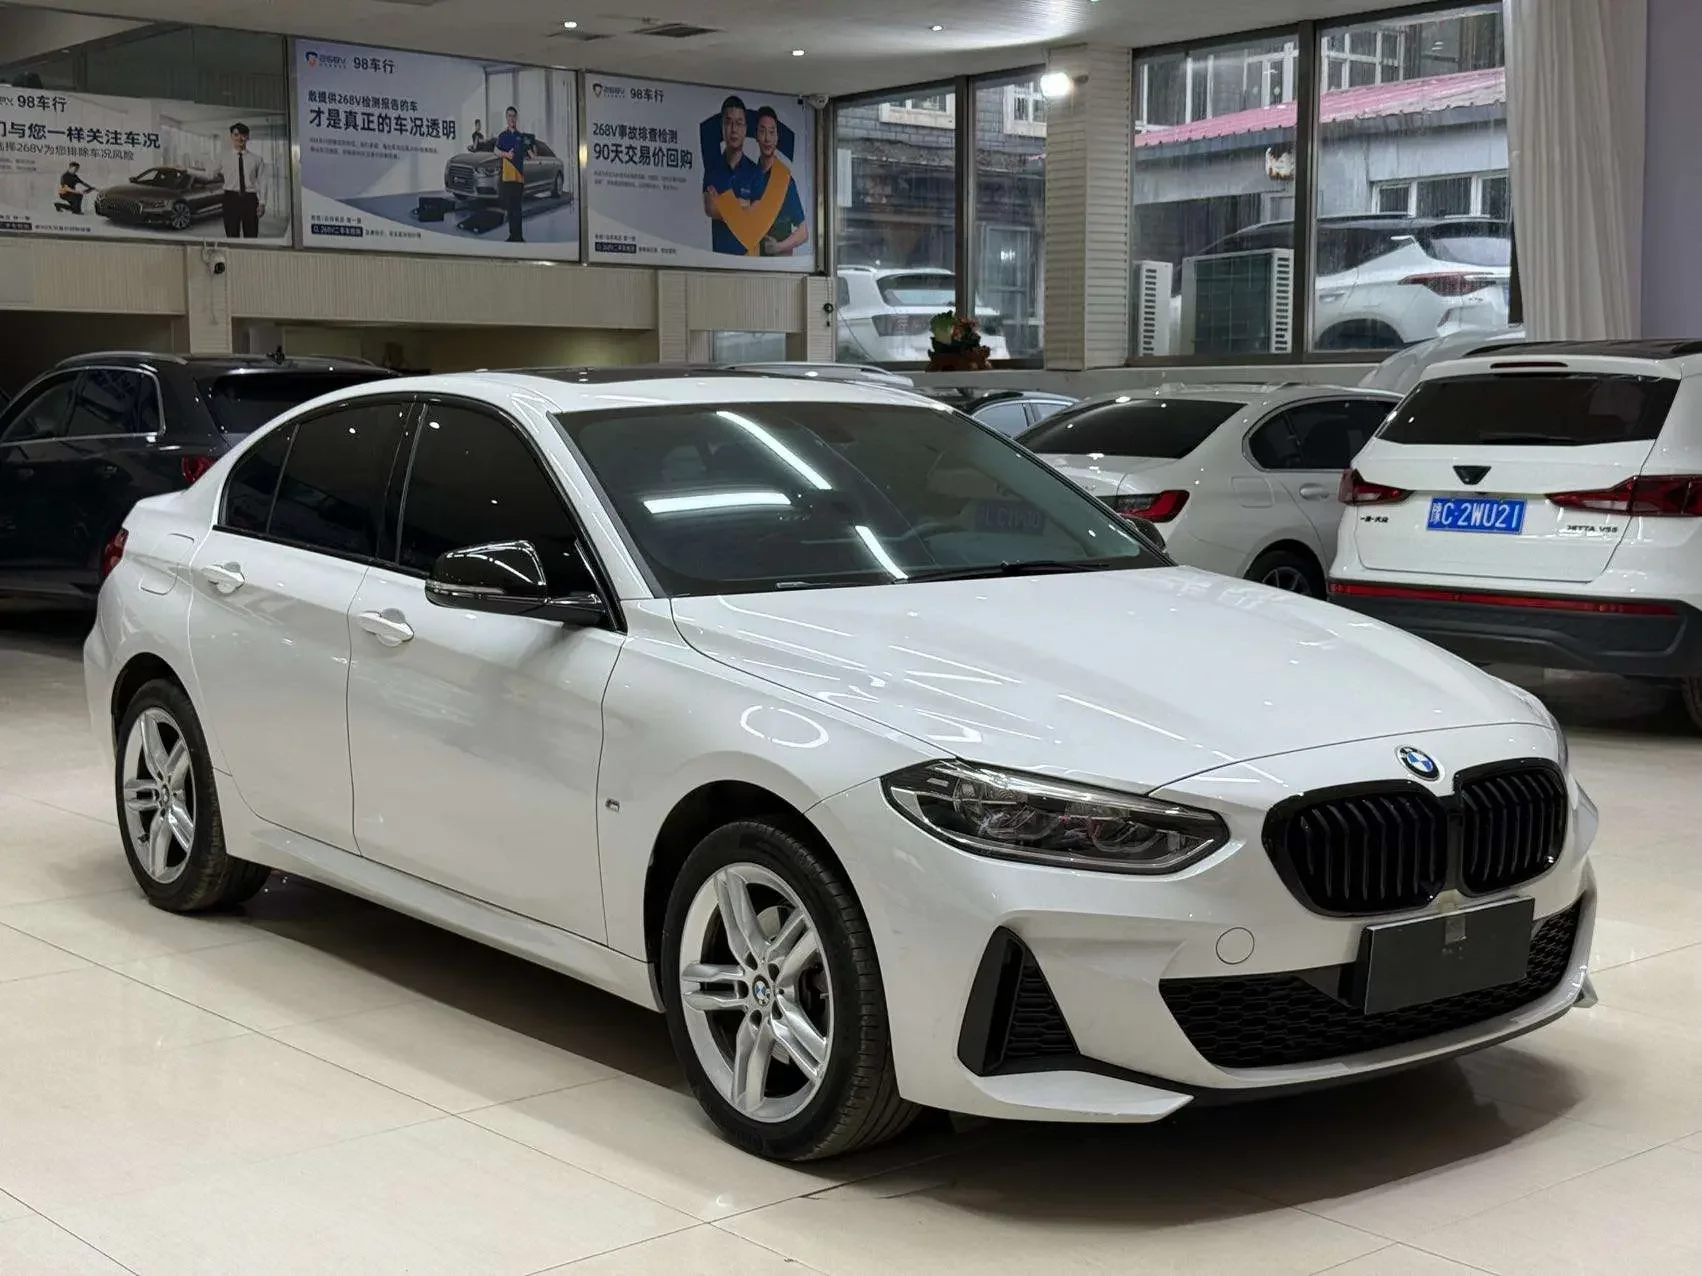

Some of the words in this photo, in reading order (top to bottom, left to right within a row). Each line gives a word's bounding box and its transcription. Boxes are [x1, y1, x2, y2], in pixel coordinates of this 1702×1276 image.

[353, 57, 395, 74] 98车行
[17, 95, 67, 113] 98车行
[630, 88, 664, 104] 98车行
[309, 107, 456, 140] 才是真正的车况透明
[594, 143, 693, 169] 90天交易价回购
